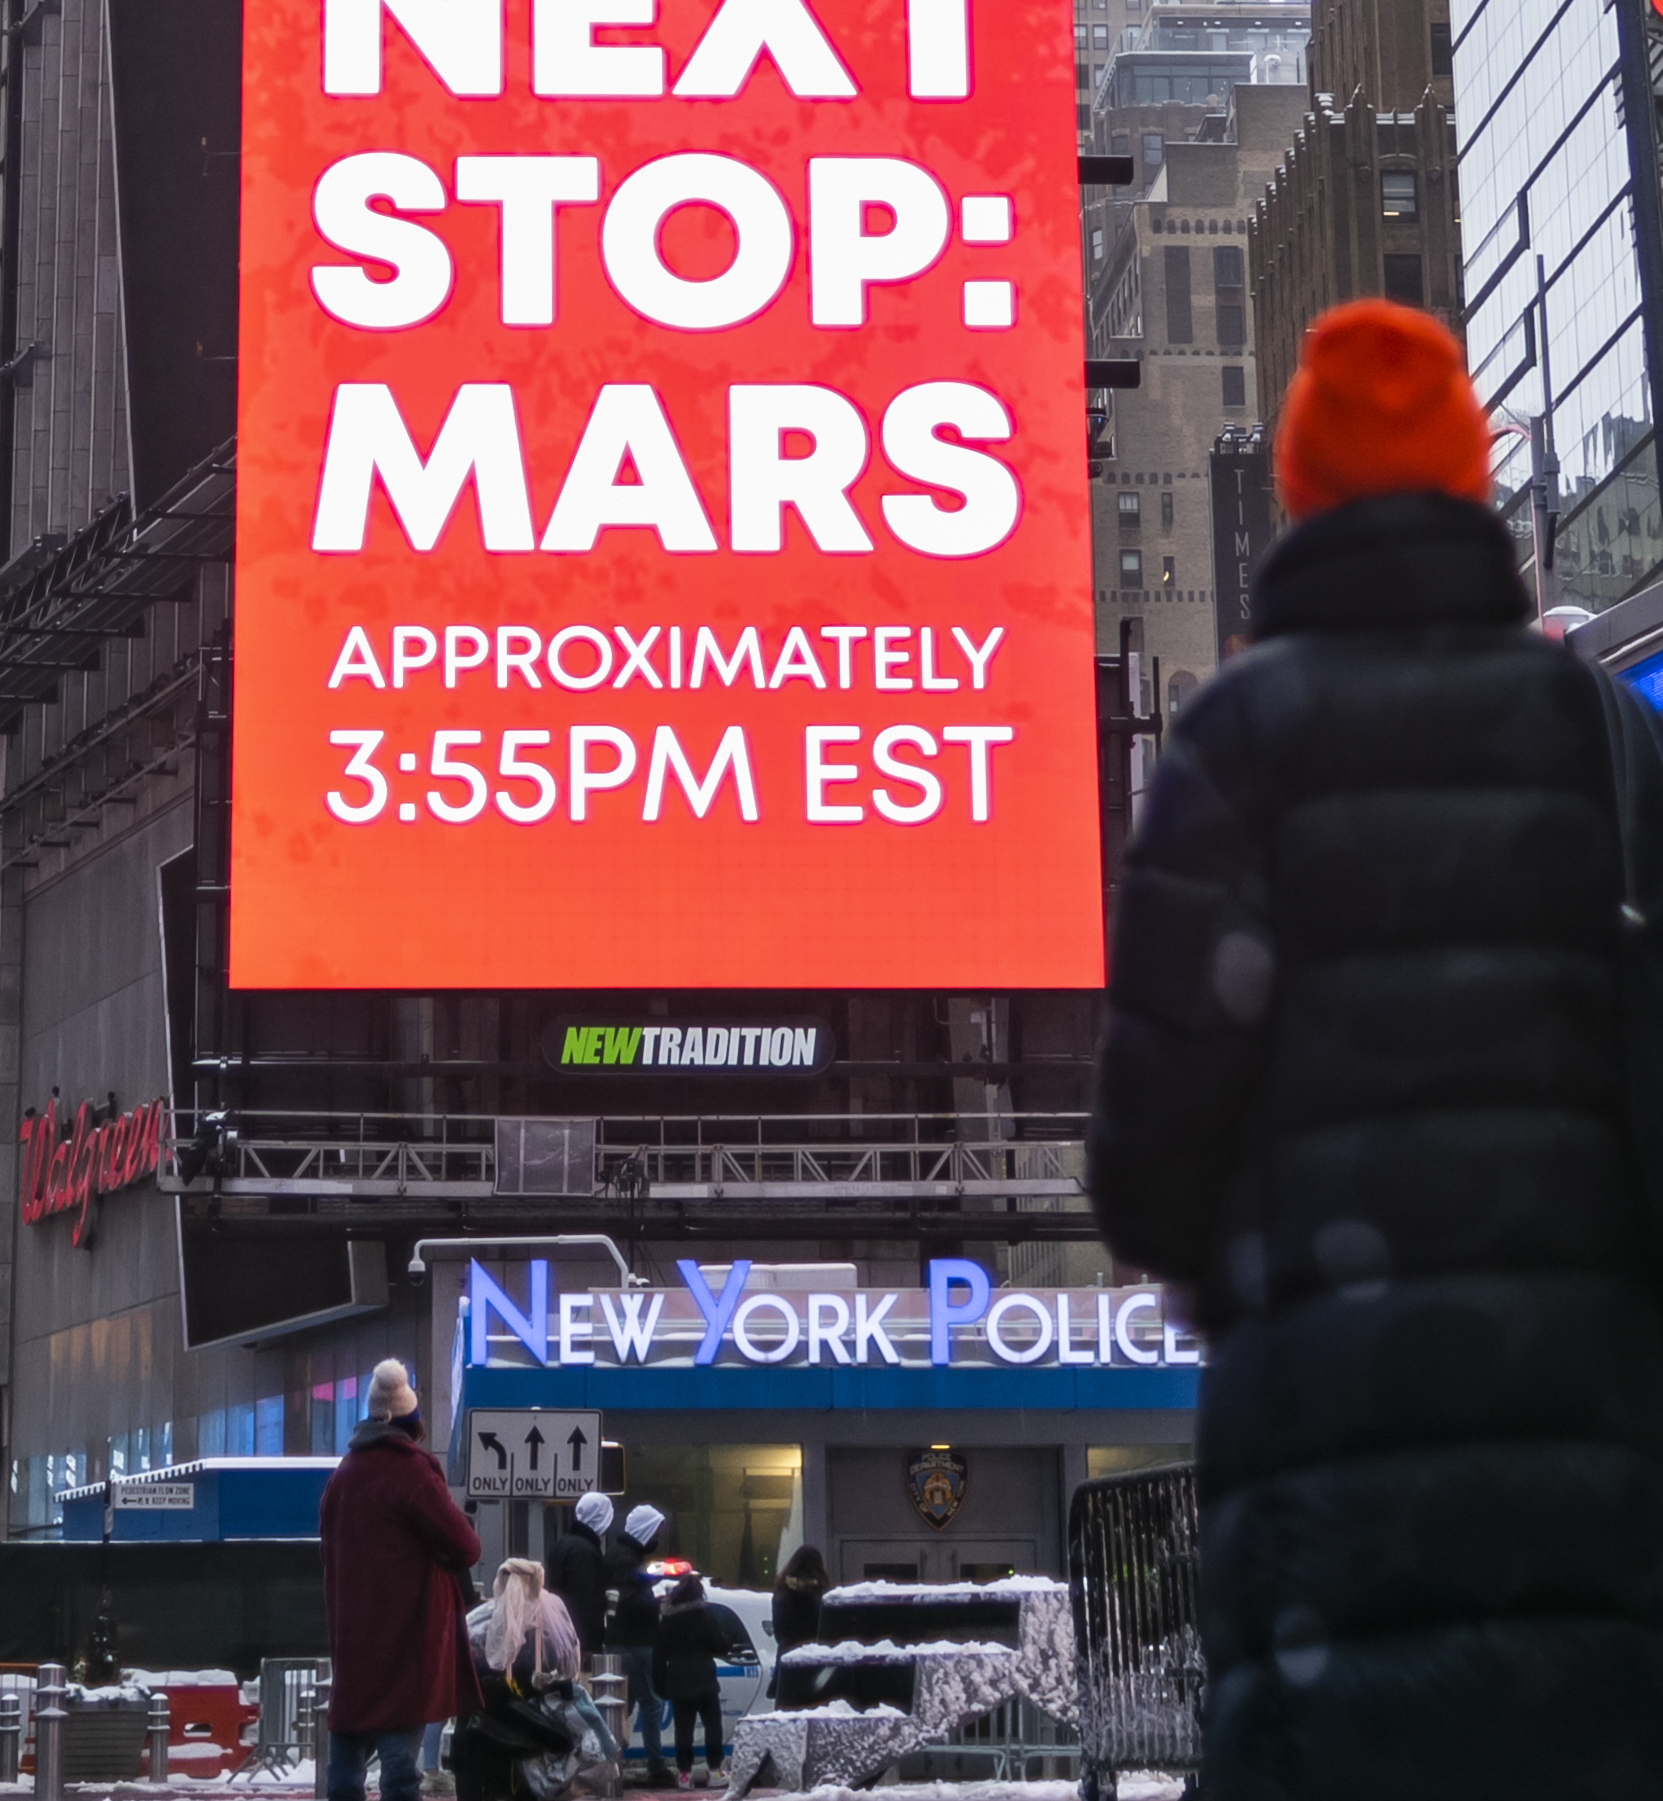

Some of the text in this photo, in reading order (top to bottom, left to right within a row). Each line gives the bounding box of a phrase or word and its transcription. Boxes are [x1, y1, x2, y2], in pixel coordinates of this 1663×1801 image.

[311, 151, 1013, 329] STOP:
[311, 381, 1020, 557] MARS
[1234, 469, 1251, 620] TIMES
[327, 625, 1004, 690] APPROXIMATELY
[327, 724, 1013, 823] 3:55PM EST
[121, 1486, 156, 1494] PEDESTRIAN
[472, 1477, 508, 1491] ONLY
[515, 1478, 551, 1491] ONLY
[557, 1478, 594, 1492] ONLY
